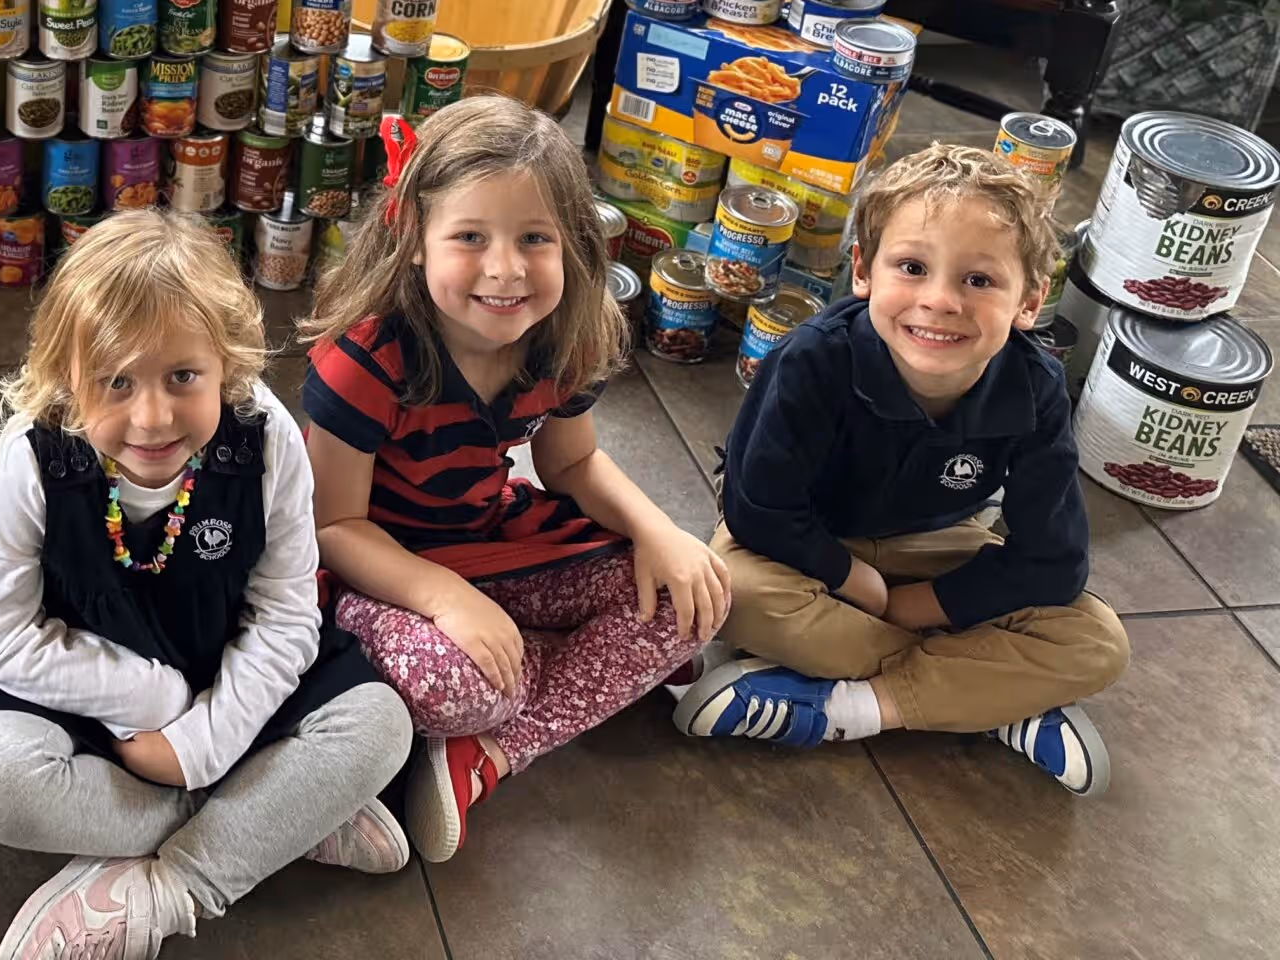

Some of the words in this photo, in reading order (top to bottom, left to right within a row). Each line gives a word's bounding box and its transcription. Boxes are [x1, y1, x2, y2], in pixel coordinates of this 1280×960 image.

[391, 1, 436, 18] CORN
[643, 2, 686, 14] ALBACORE
[46, 18, 74, 29] Sweet
[151, 62, 194, 75] MISSION
[833, 57, 872, 76] ALBACORE
[829, 82, 847, 98] 12
[817, 92, 857, 112] pack
[768, 111, 795, 124] original
[769, 117, 792, 129] flavor
[1223, 193, 1270, 212] CREEK
[719, 225, 764, 245] PROGRESSO
[1163, 220, 1241, 240] KIDNEY
[1154, 235, 1233, 266] BEANS
[661, 297, 709, 310] PROGRESSO
[1129, 362, 1180, 395] WEST
[1203, 388, 1256, 406] CREEK
[1142, 405, 1229, 435] KIDNEY
[1134, 421, 1219, 457] BEANS
[189, 518, 232, 537] PRIMROSE
